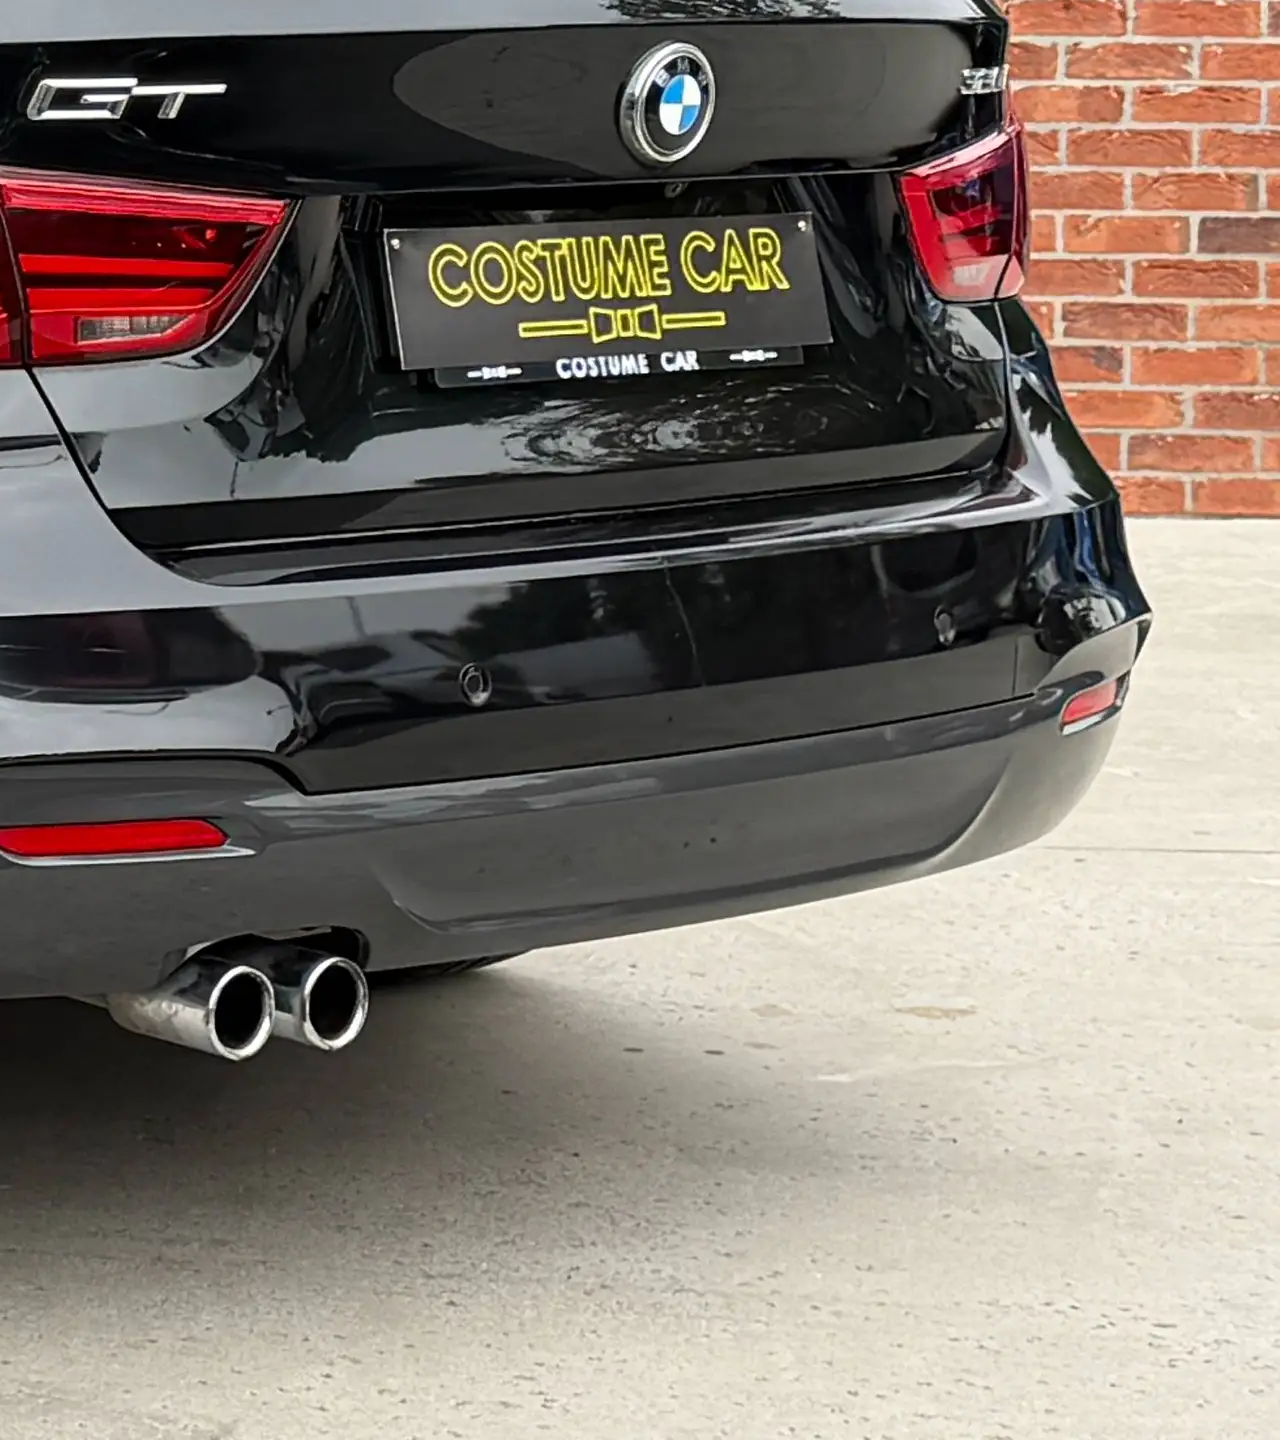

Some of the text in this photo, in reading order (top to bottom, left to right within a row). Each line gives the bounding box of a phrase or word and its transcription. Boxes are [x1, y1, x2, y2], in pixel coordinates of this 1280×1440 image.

[27, 77, 228, 121] GT
[428, 227, 791, 308] COSTUME CAR
[555, 350, 701, 380] COSTUME CAR
